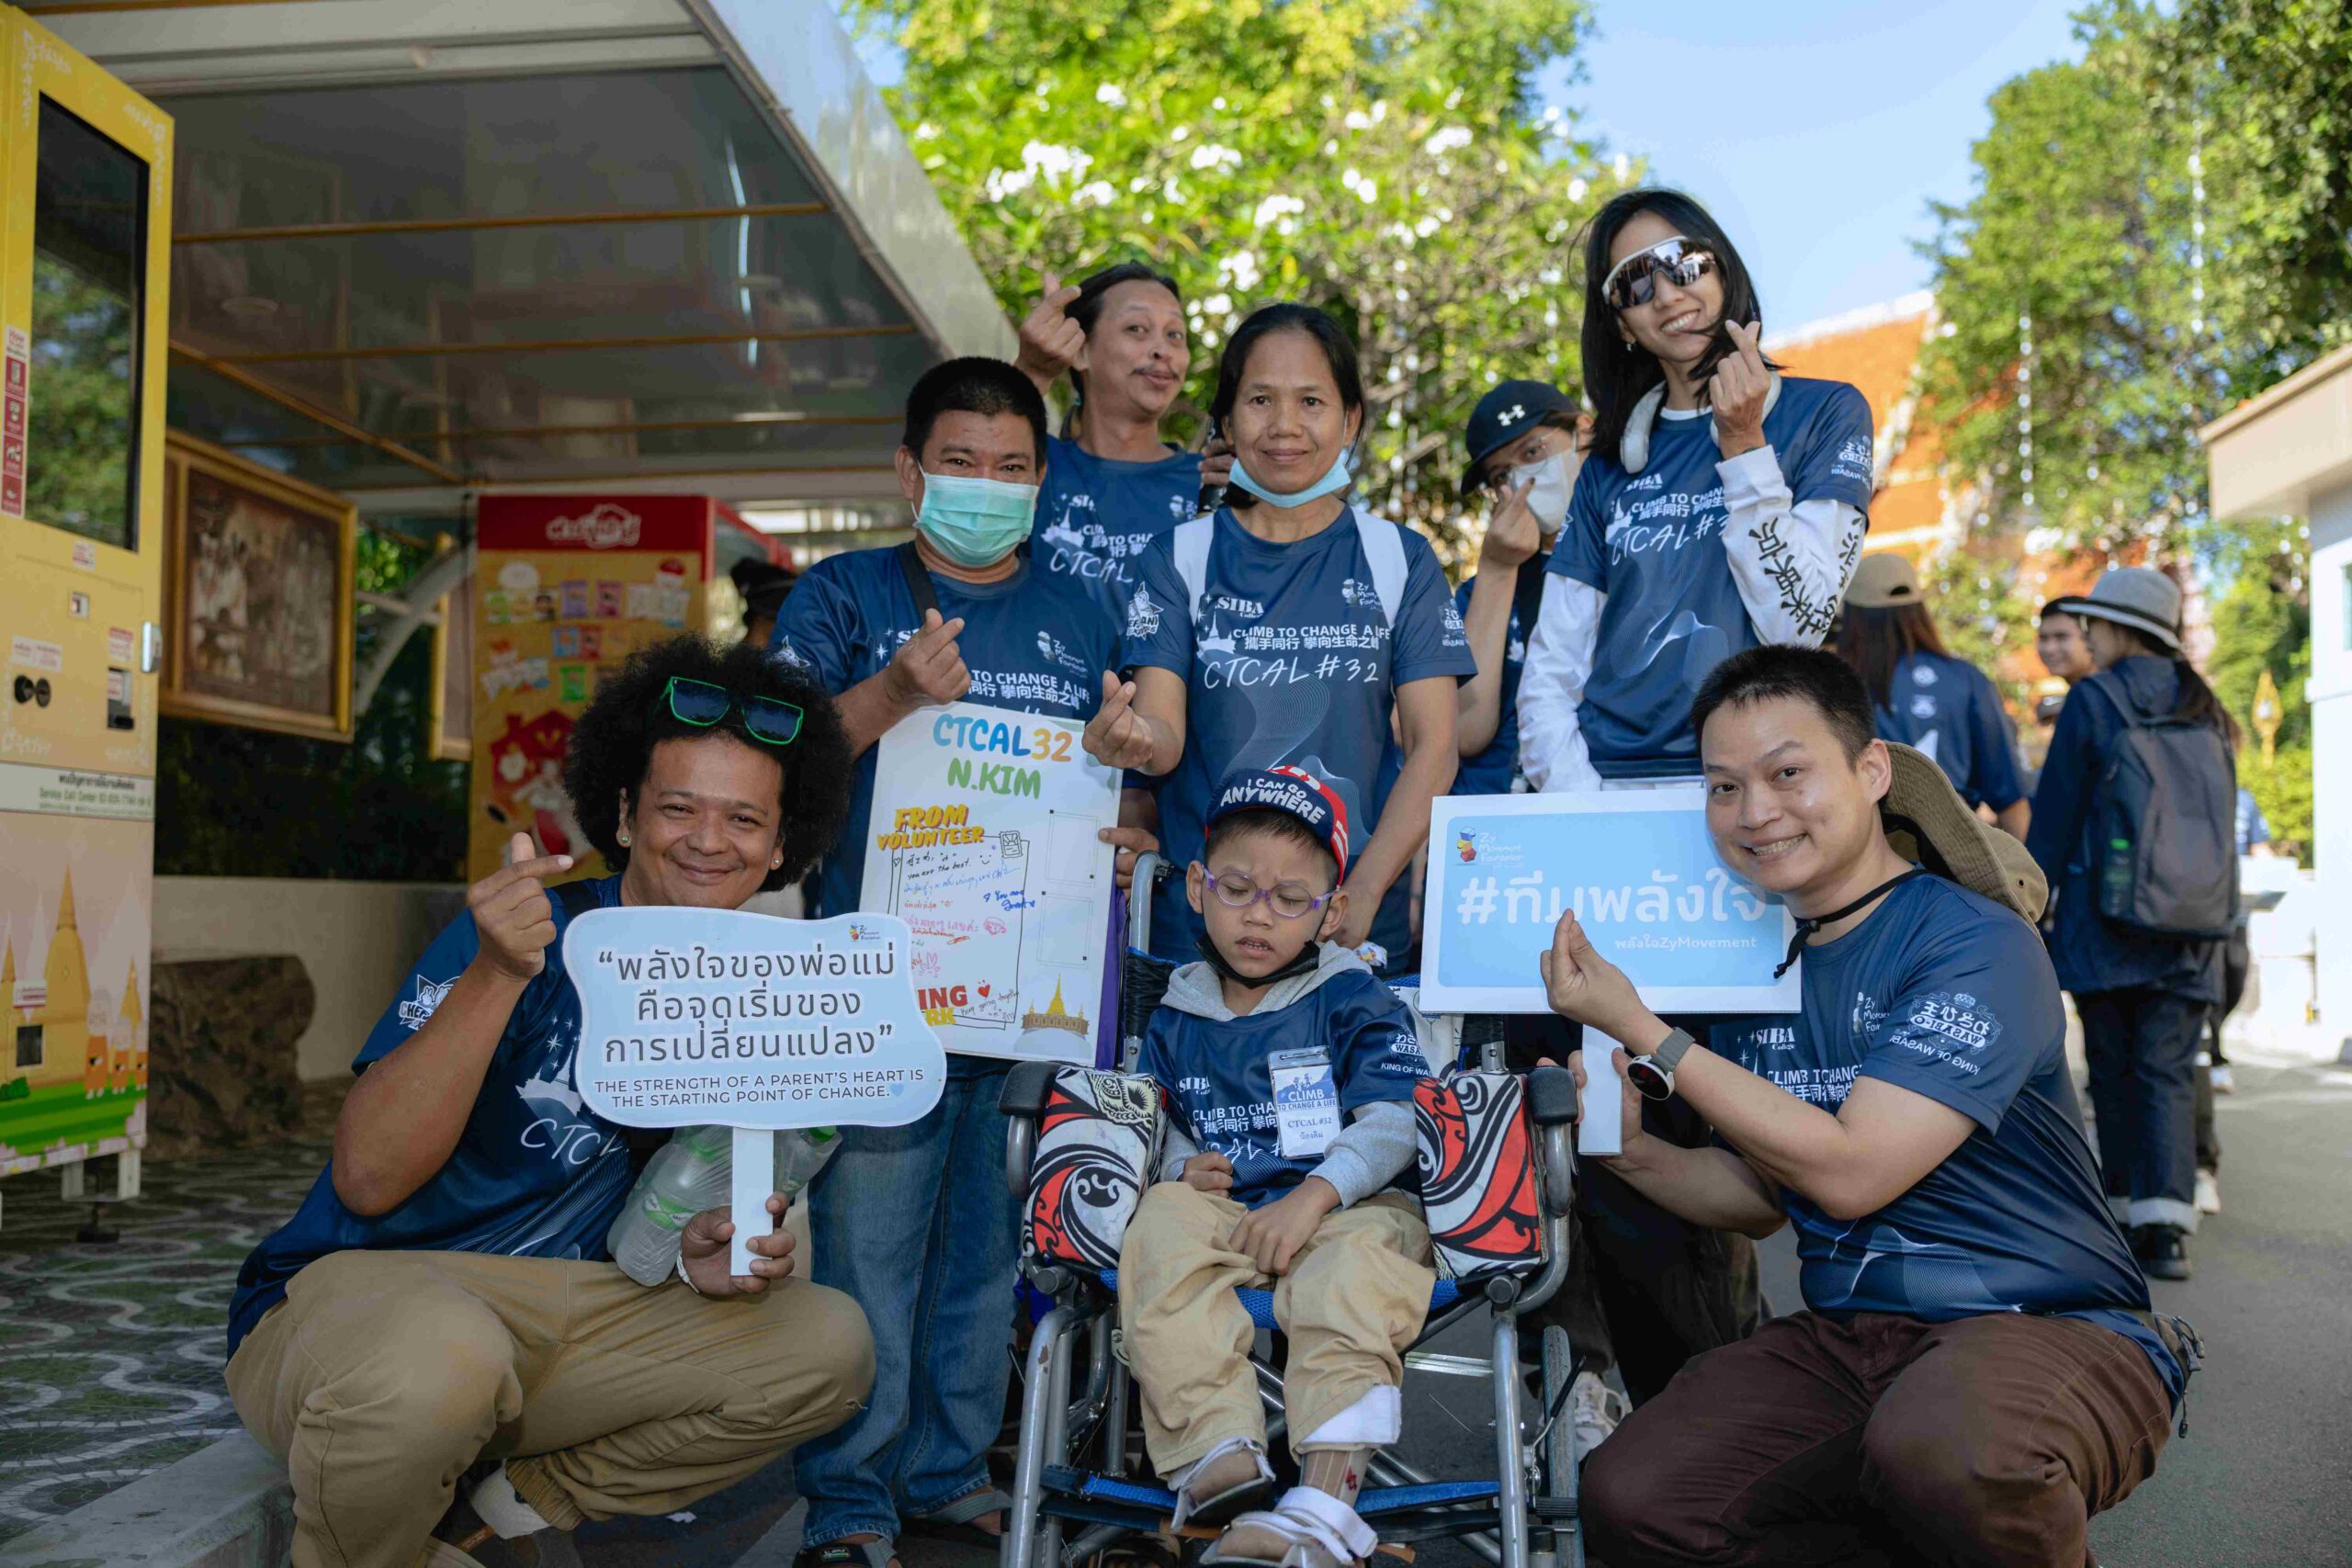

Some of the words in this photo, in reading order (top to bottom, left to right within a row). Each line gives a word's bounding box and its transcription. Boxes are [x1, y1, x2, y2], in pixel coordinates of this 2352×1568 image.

[1670, 493, 1689, 503] TO
[1691, 487, 1724, 505] CHAN
[1109, 536, 1125, 545] TO
[1127, 534, 1153, 544] CHA
[1049, 548, 1134, 582] CTCAL
[1215, 597, 1264, 614] SIBA
[1233, 626, 1274, 638] CLIMB
[1278, 627, 1297, 637] TO
[1300, 625, 1358, 637] CHANGE
[1363, 626, 1374, 636] A
[971, 670, 992, 682] TO
[996, 672, 1057, 687] CHANGE
[1063, 681, 1072, 693] A
[1204, 656, 1310, 689] CTCAL
[968, 681, 997, 697] 同行
[933, 714, 1073, 761] CTCAL32
[947, 757, 1041, 800] N.KIM
[1248, 779, 1251, 787] I
[1255, 778, 1285, 790] CAN
[1287, 784, 1306, 798] GO
[1220, 786, 1326, 825] ANYWHERE
[894, 804, 969, 831] FROM
[876, 826, 985, 852] VOLUNTEER
[1480, 833, 1497, 843] Zy
[1479, 844, 1521, 852] Movement
[638, 980, 861, 1028] คือจุดเริ่มของ
[917, 985, 967, 1010] ING
[1865, 997, 1876, 1009] Zy
[925, 1007, 956, 1027] RK
[1756, 1026, 1795, 1044] SIBA
[1395, 1044, 1421, 1055] WASA
[1381, 1062, 1401, 1072] KING
[1822, 1065, 1862, 1084] CHANG
[594, 1080, 628, 1093] THE
[634, 1076, 720, 1091] STRENGTH
[727, 1075, 748, 1088] OF
[753, 1075, 765, 1087] A
[854, 1070, 905, 1083] HEART
[909, 1069, 924, 1081] IS
[612, 1095, 646, 1108] THE
[650, 1091, 730, 1106] STARTING
[736, 1089, 785, 1102] POINT
[792, 1088, 814, 1100] OF
[820, 1084, 890, 1100] CHANGE.
[1288, 1089, 1325, 1101] CLIMB
[1228, 1106, 1246, 1117] TO
[1249, 1102, 1275, 1115] CHA
[1288, 1100, 1316, 1110] CHANGE
[1323, 1099, 1337, 1107] LIFE
[1287, 1118, 1319, 1128] CTCAL
[1319, 1117, 1332, 1125] #32
